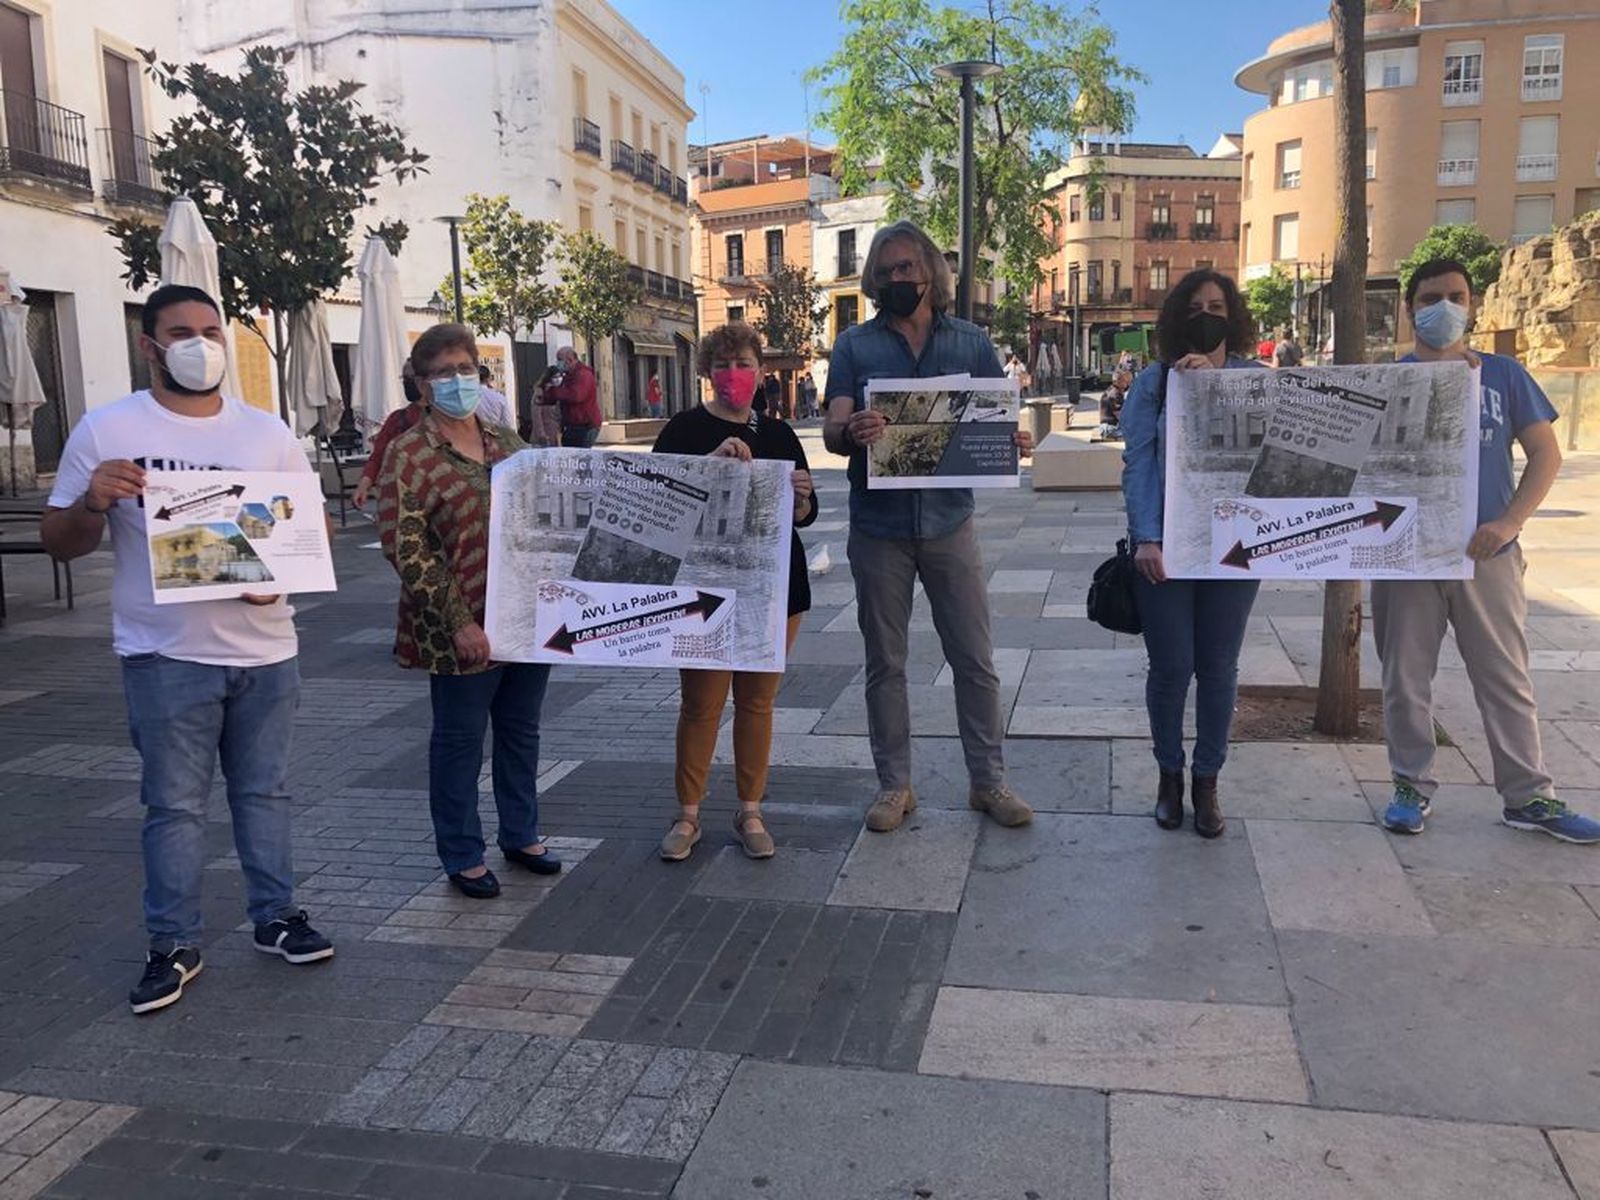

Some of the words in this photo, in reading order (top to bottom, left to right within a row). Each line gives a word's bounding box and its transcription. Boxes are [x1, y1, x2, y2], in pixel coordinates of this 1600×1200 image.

[1263, 377, 1298, 389] PASA
[1301, 376, 1321, 389] del
[1216, 393, 1254, 406] Habrá
[1256, 395, 1281, 409] que
[590, 459, 625, 473] PASA
[627, 462, 647, 474] del
[543, 473, 581, 486] Habrá
[583, 476, 606, 489] que
[1255, 520, 1286, 536] AVV.
[1287, 515, 1304, 528] La
[1305, 501, 1356, 522] Palabra
[1251, 546, 1270, 558] LAS
[1270, 532, 1317, 554] MORERAS
[1279, 551, 1294, 563] Un
[1295, 544, 1323, 560] barrio
[1323, 538, 1348, 549] toma
[1294, 562, 1305, 572] la
[1304, 554, 1339, 571] palabra
[581, 605, 611, 621] AVV.
[612, 600, 629, 614] La
[630, 589, 679, 609] Palabra
[575, 629, 594, 642] LAS
[595, 618, 642, 637] MORERAS
[602, 637, 618, 649] Un
[619, 631, 647, 646] barrio
[647, 625, 672, 638] toma
[618, 648, 628, 658] la
[629, 640, 662, 657] palabra
